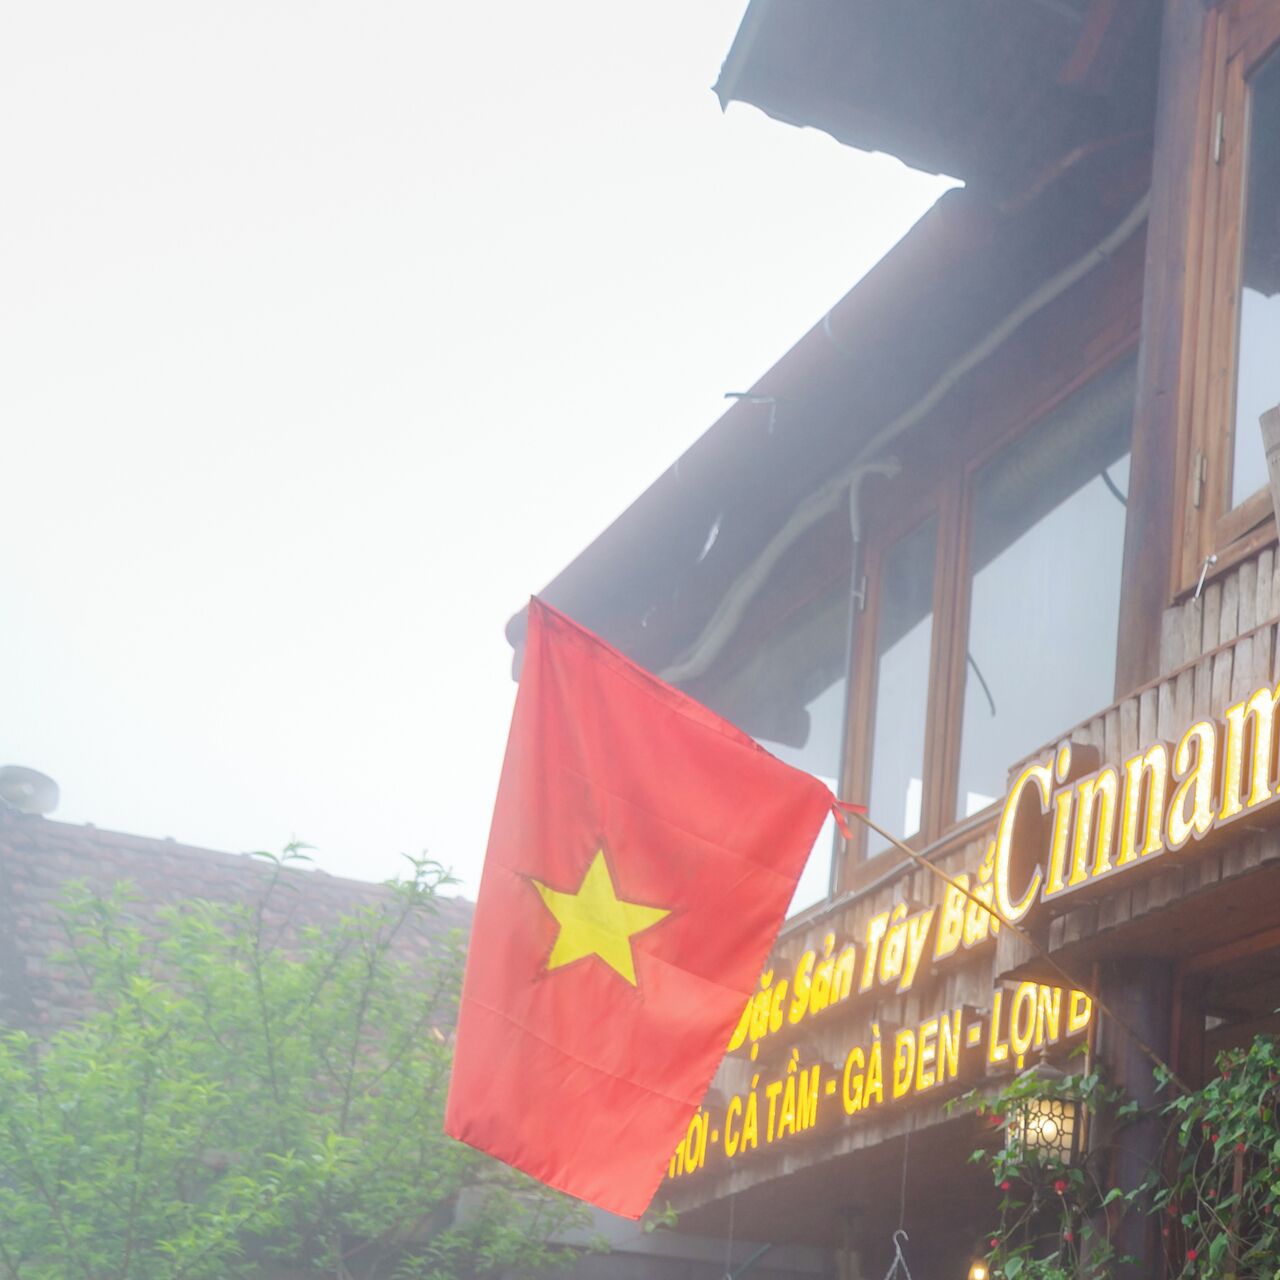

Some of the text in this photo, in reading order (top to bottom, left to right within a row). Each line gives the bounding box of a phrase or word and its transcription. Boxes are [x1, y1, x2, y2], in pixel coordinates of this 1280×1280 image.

[861, 902, 934, 990] Tây
[724, 1073, 760, 1158] CÁ
[842, 1023, 883, 1115] GÀ
[892, 1008, 962, 1099] ĐEN
